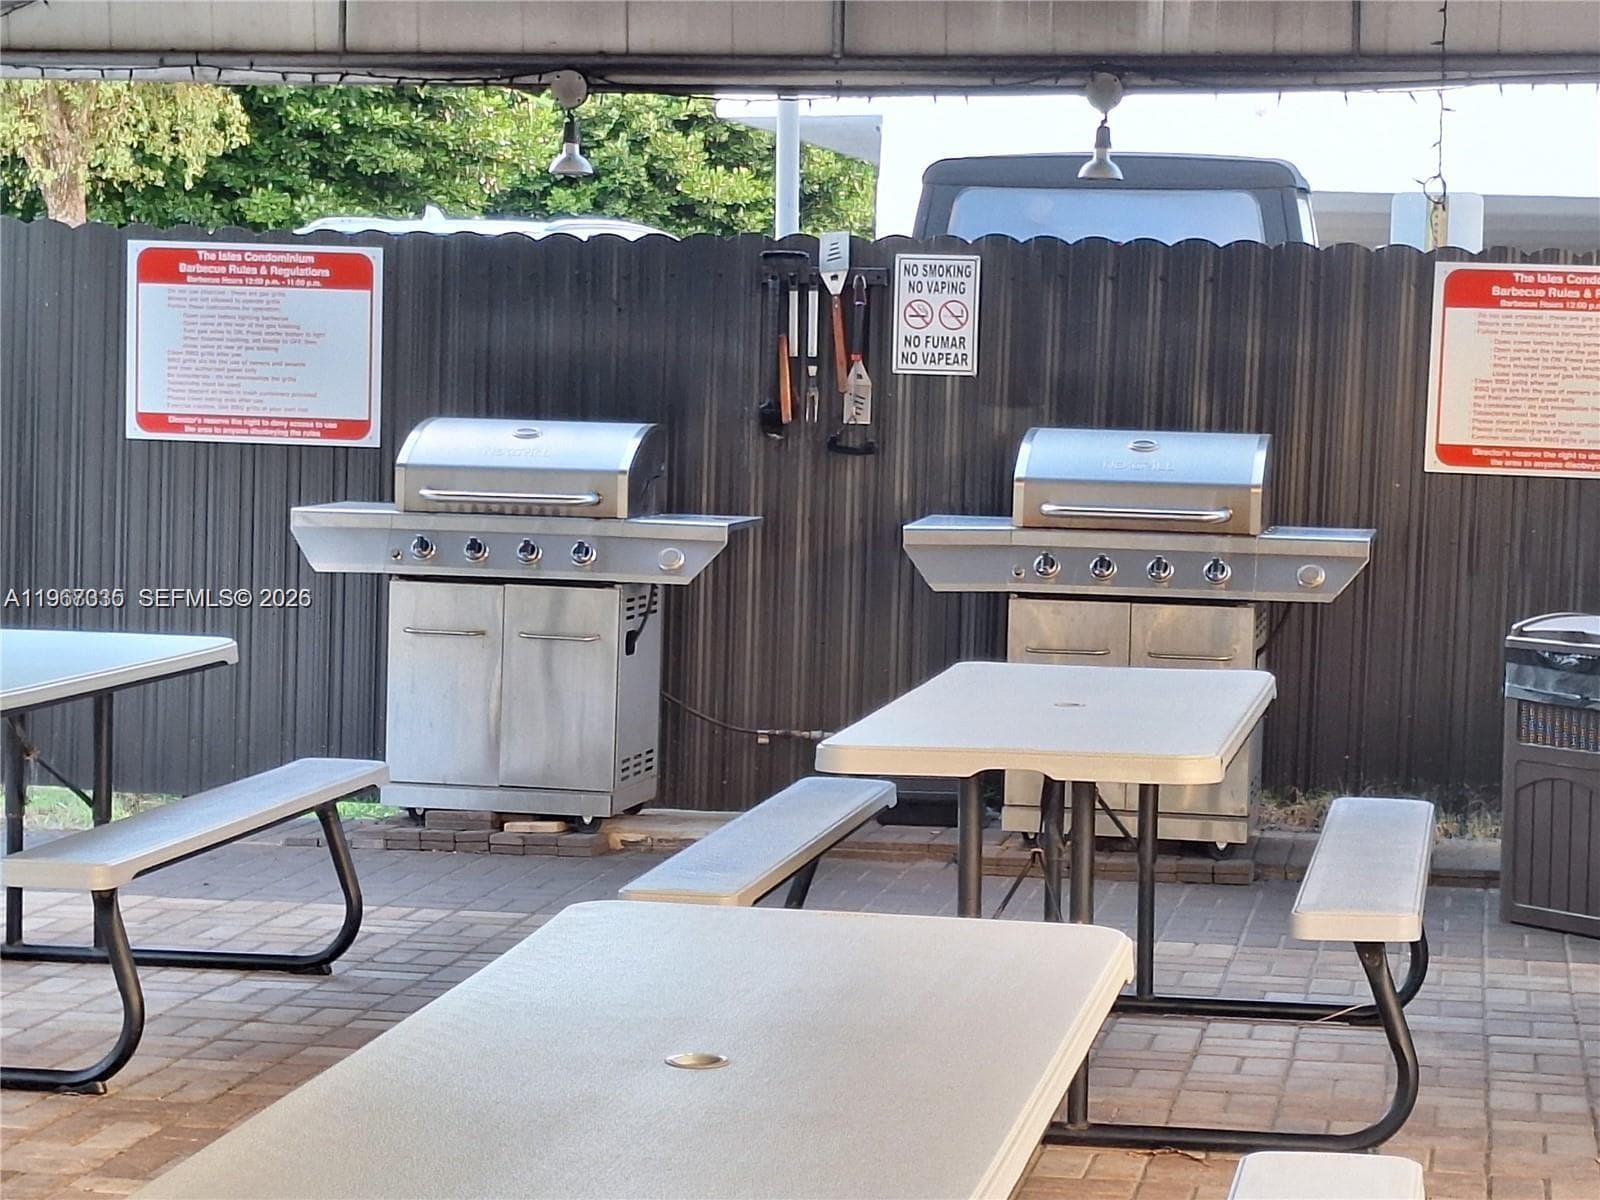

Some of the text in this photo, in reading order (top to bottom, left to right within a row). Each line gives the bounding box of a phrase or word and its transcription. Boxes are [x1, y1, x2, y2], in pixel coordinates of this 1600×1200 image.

[197, 250, 315, 264] The Isles Condominium
[179, 262, 330, 277] Barbecue Rules & Regulations
[904, 264, 972, 278] NO SMOKING
[1513, 272, 1535, 283] The
[1537, 273, 1563, 284] Isles
[908, 281, 966, 295] NO VAPING
[1491, 285, 1546, 297] Barbecue
[1548, 287, 1580, 298] Rules
[1583, 288, 1592, 298] &
[904, 336, 966, 349] NO FUMAR
[901, 352, 968, 366] NO VAPEAR
